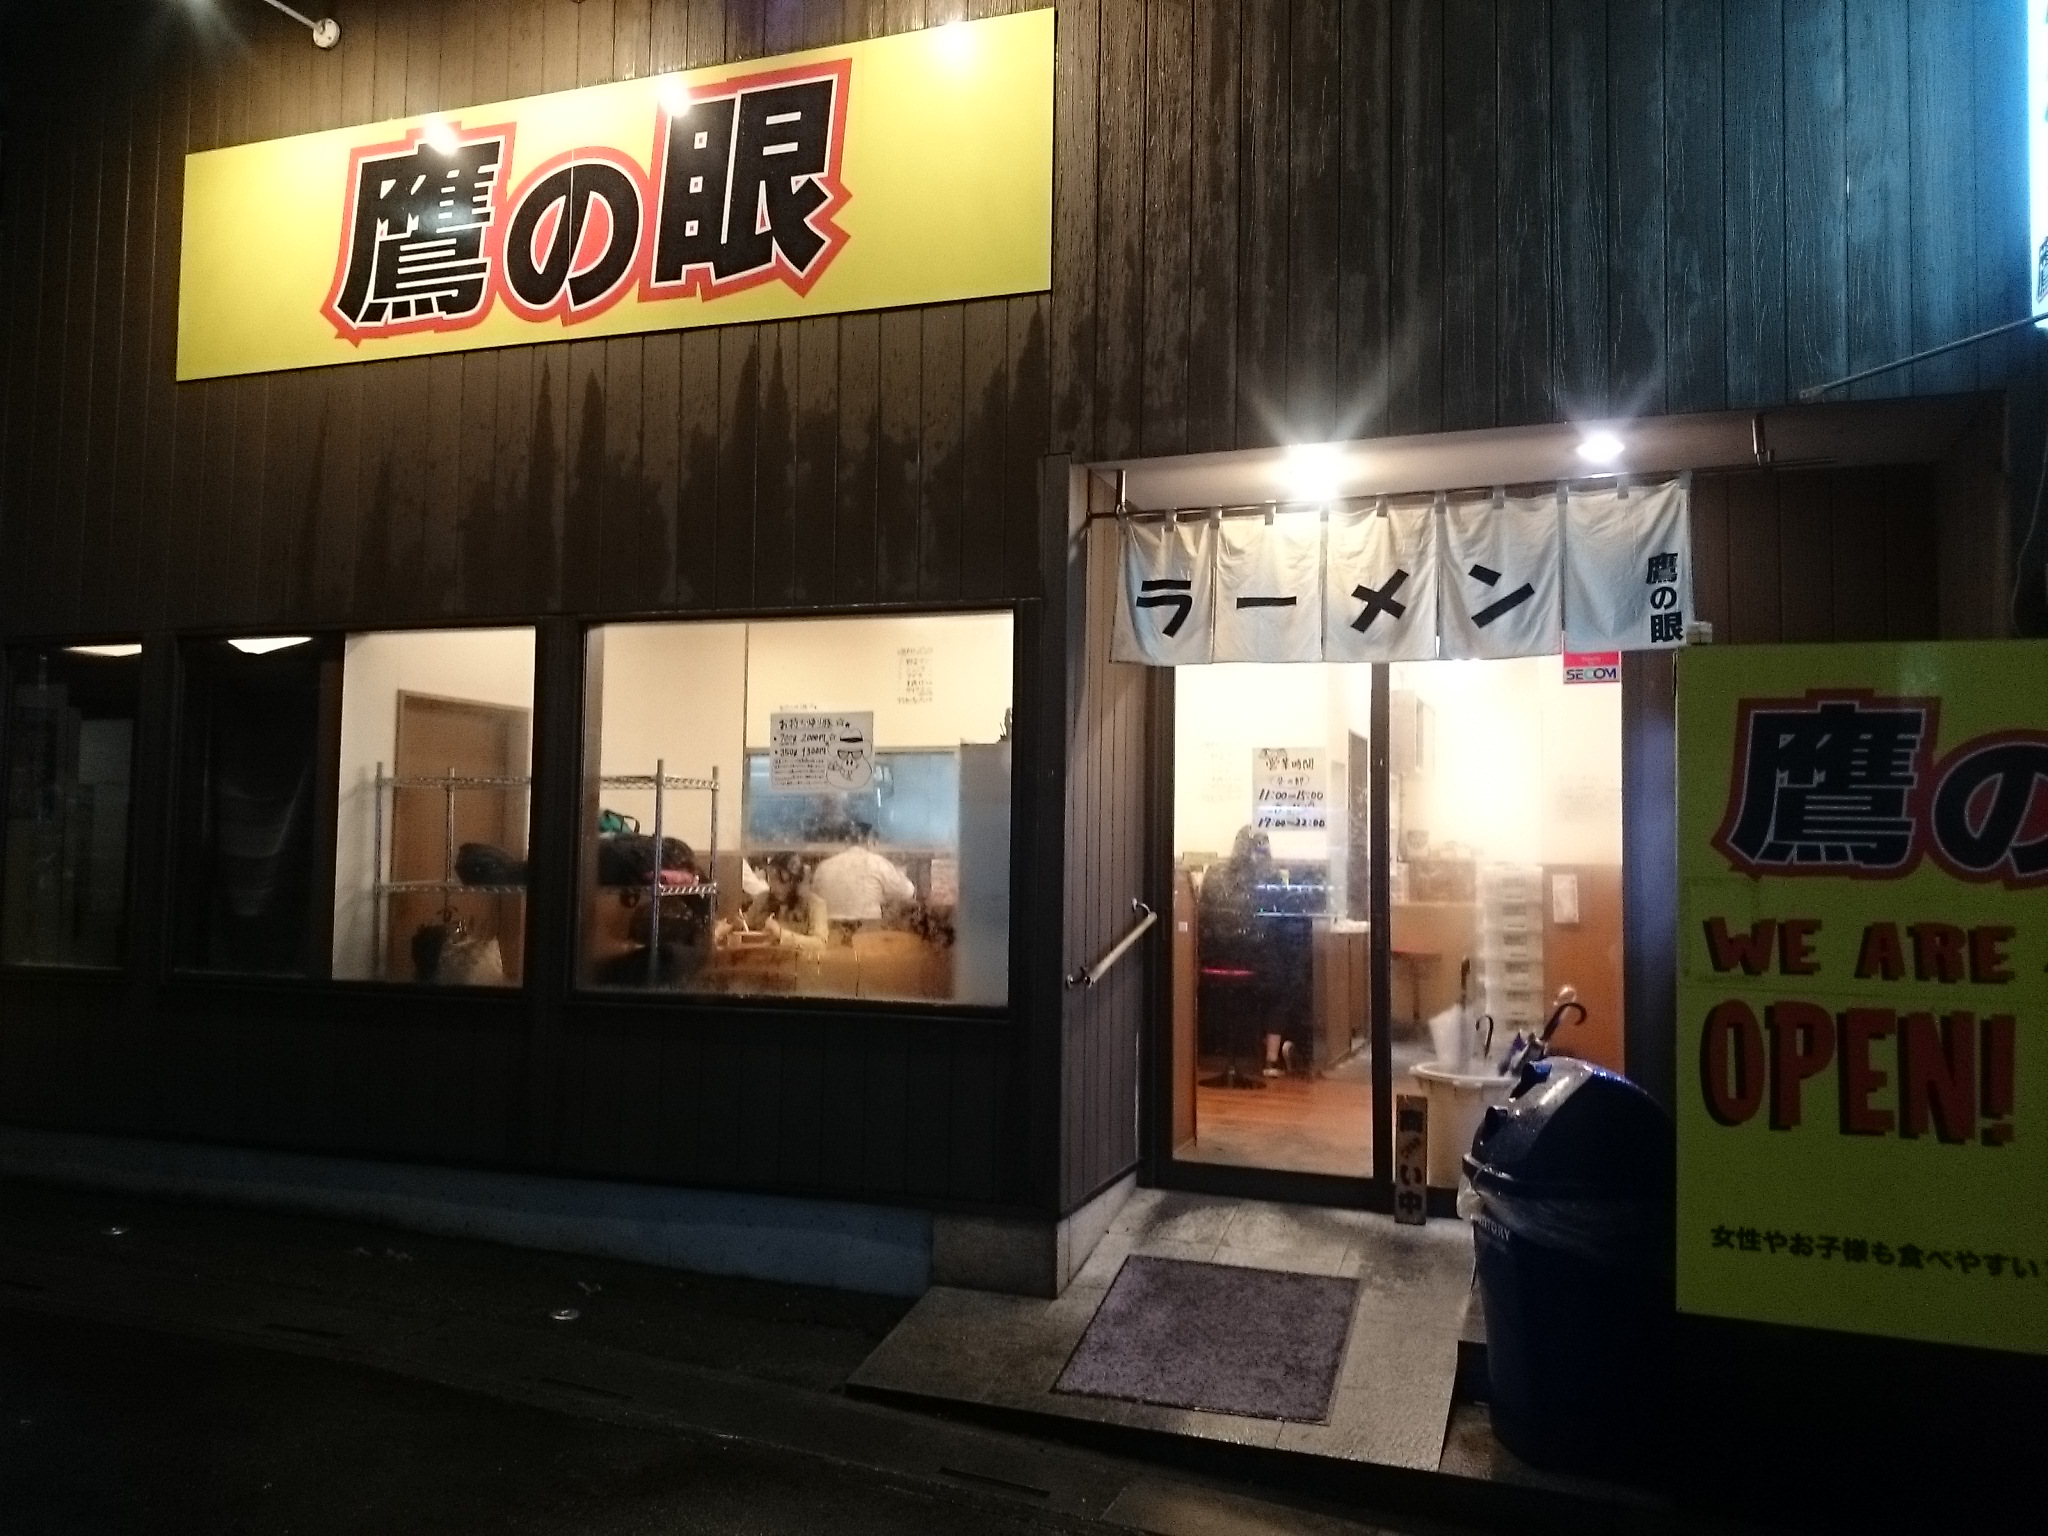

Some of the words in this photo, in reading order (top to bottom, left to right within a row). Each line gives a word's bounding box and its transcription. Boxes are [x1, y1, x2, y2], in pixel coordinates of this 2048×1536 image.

[331, 74, 838, 328] 鷹の眼
[1136, 563, 1535, 637] ラーメン
[1646, 552, 1684, 643] 鷹の眼
[1566, 667, 1617, 681] SECOM
[1702, 917, 1822, 976] WE
[1853, 922, 2016, 984] ARE
[1699, 998, 2017, 1147] OPEN!
